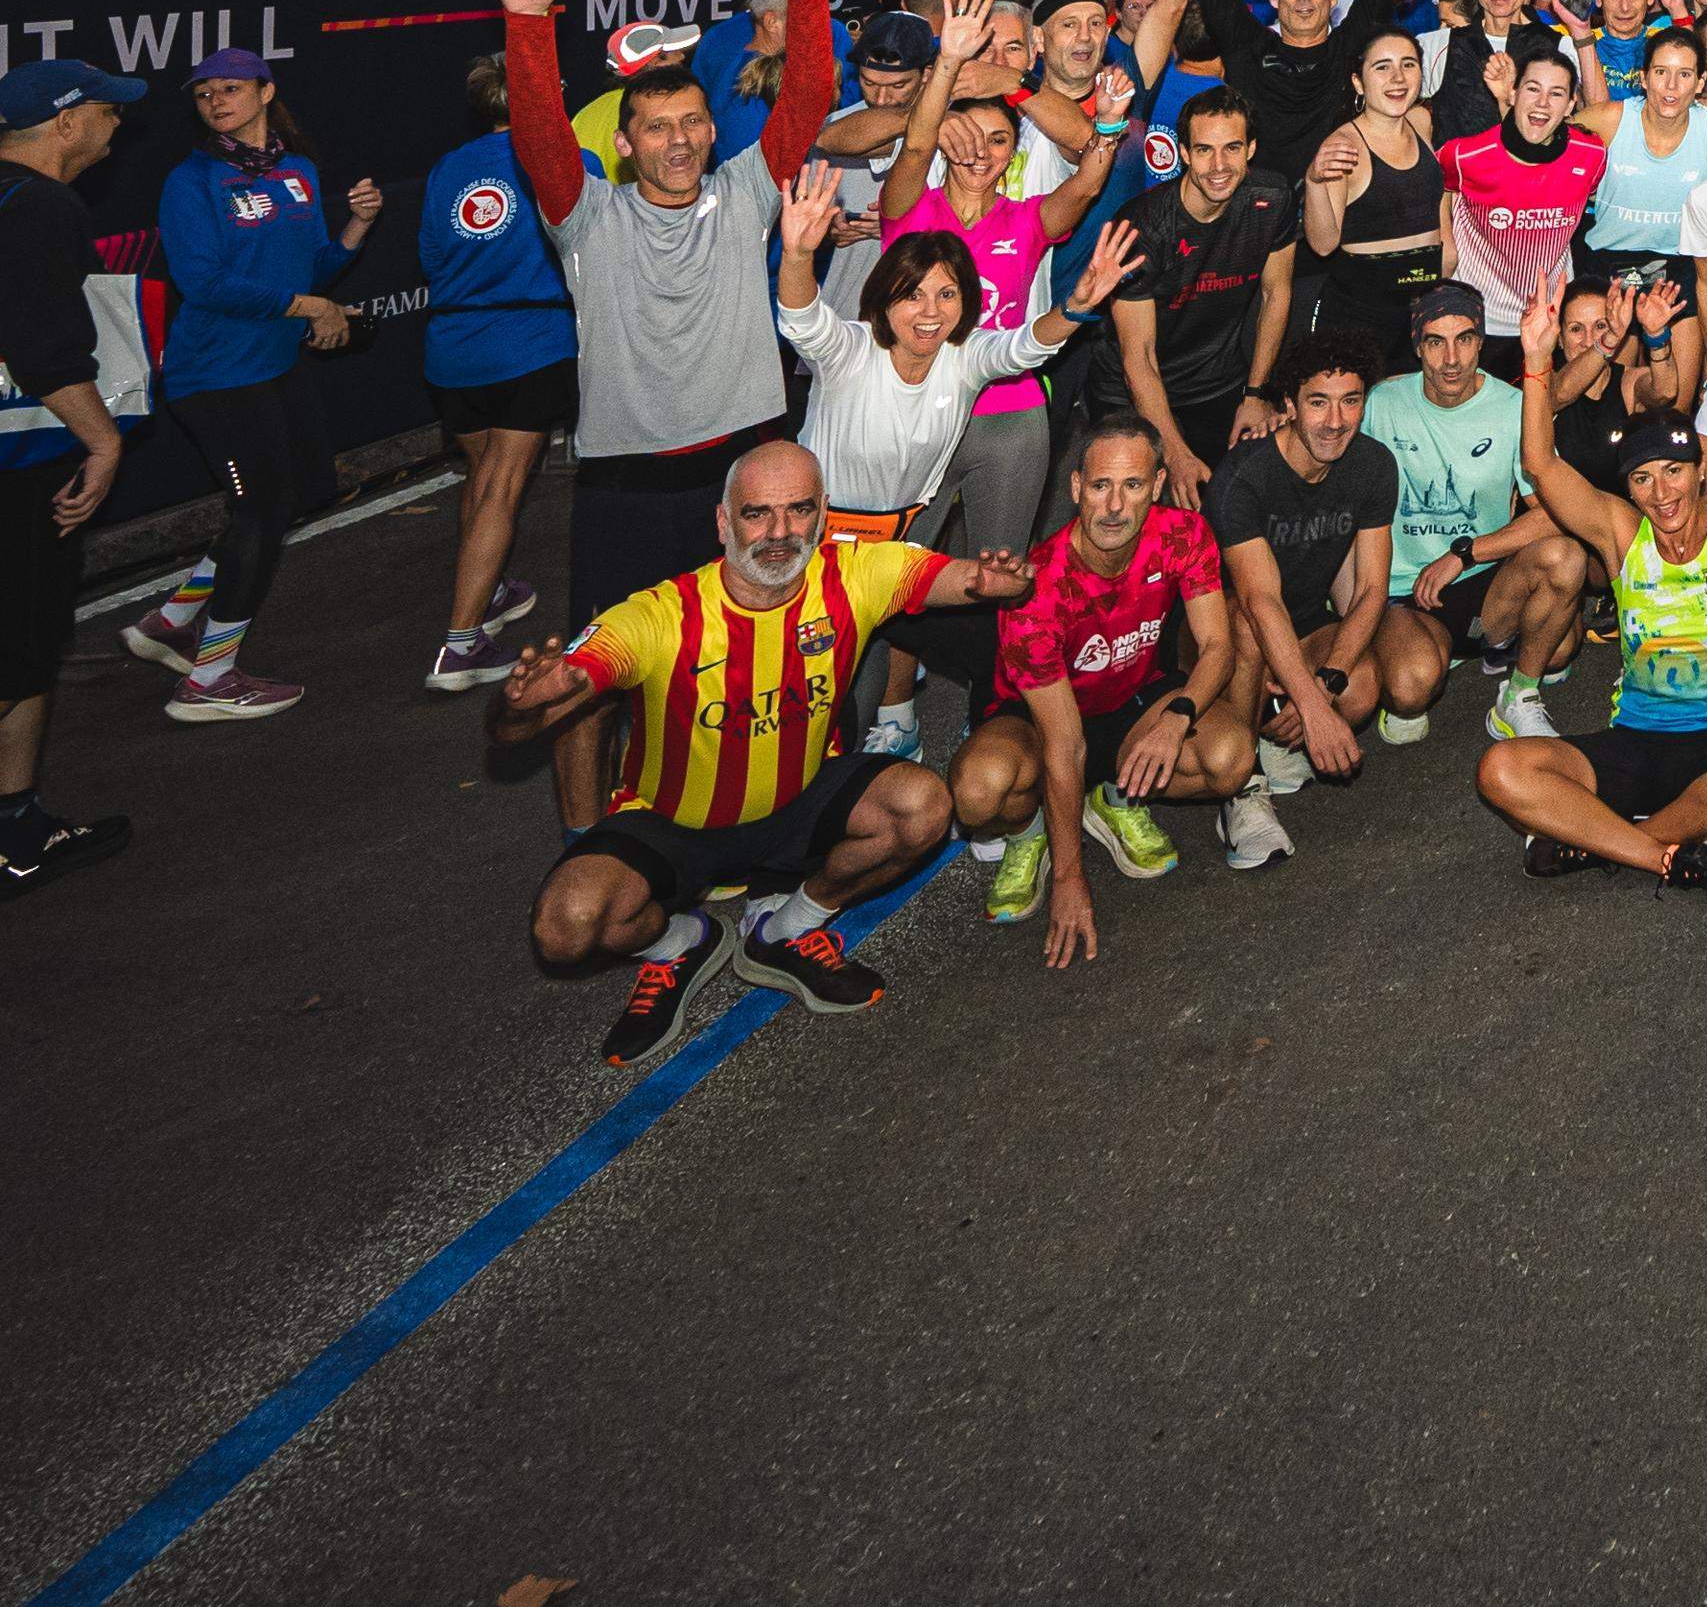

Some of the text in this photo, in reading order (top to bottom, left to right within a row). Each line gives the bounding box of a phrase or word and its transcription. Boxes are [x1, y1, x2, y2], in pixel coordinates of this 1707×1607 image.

[108, 6, 295, 73] WILL
[1514, 215, 1577, 231] RUNNERS
[1516, 207, 1565, 220] ACTIVE
[699, 674, 830, 731] QATAR
